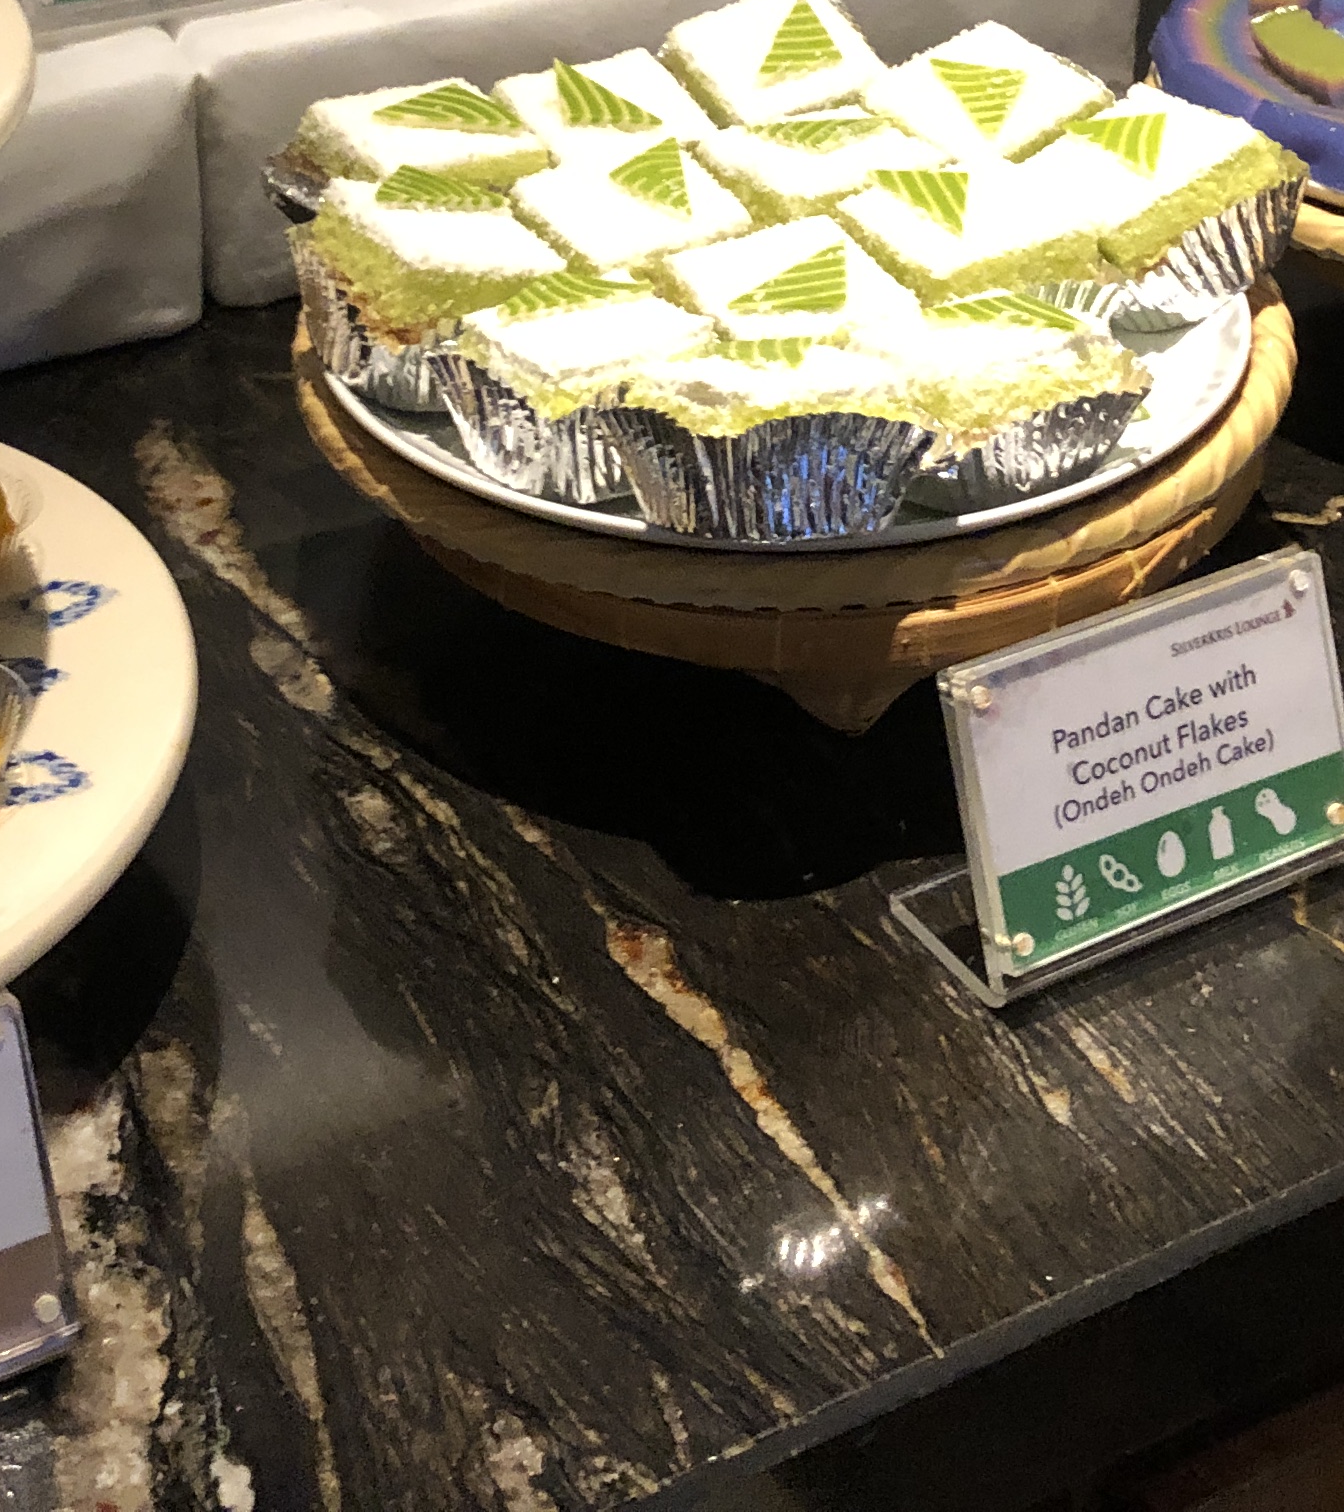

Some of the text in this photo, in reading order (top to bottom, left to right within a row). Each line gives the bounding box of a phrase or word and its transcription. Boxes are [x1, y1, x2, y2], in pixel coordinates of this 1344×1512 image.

[1052, 663, 1258, 754] Pandan Cake with
[1071, 709, 1250, 786] Coconut Flakes
[1054, 728, 1276, 830] (Ondeh Ondeh Cake)
